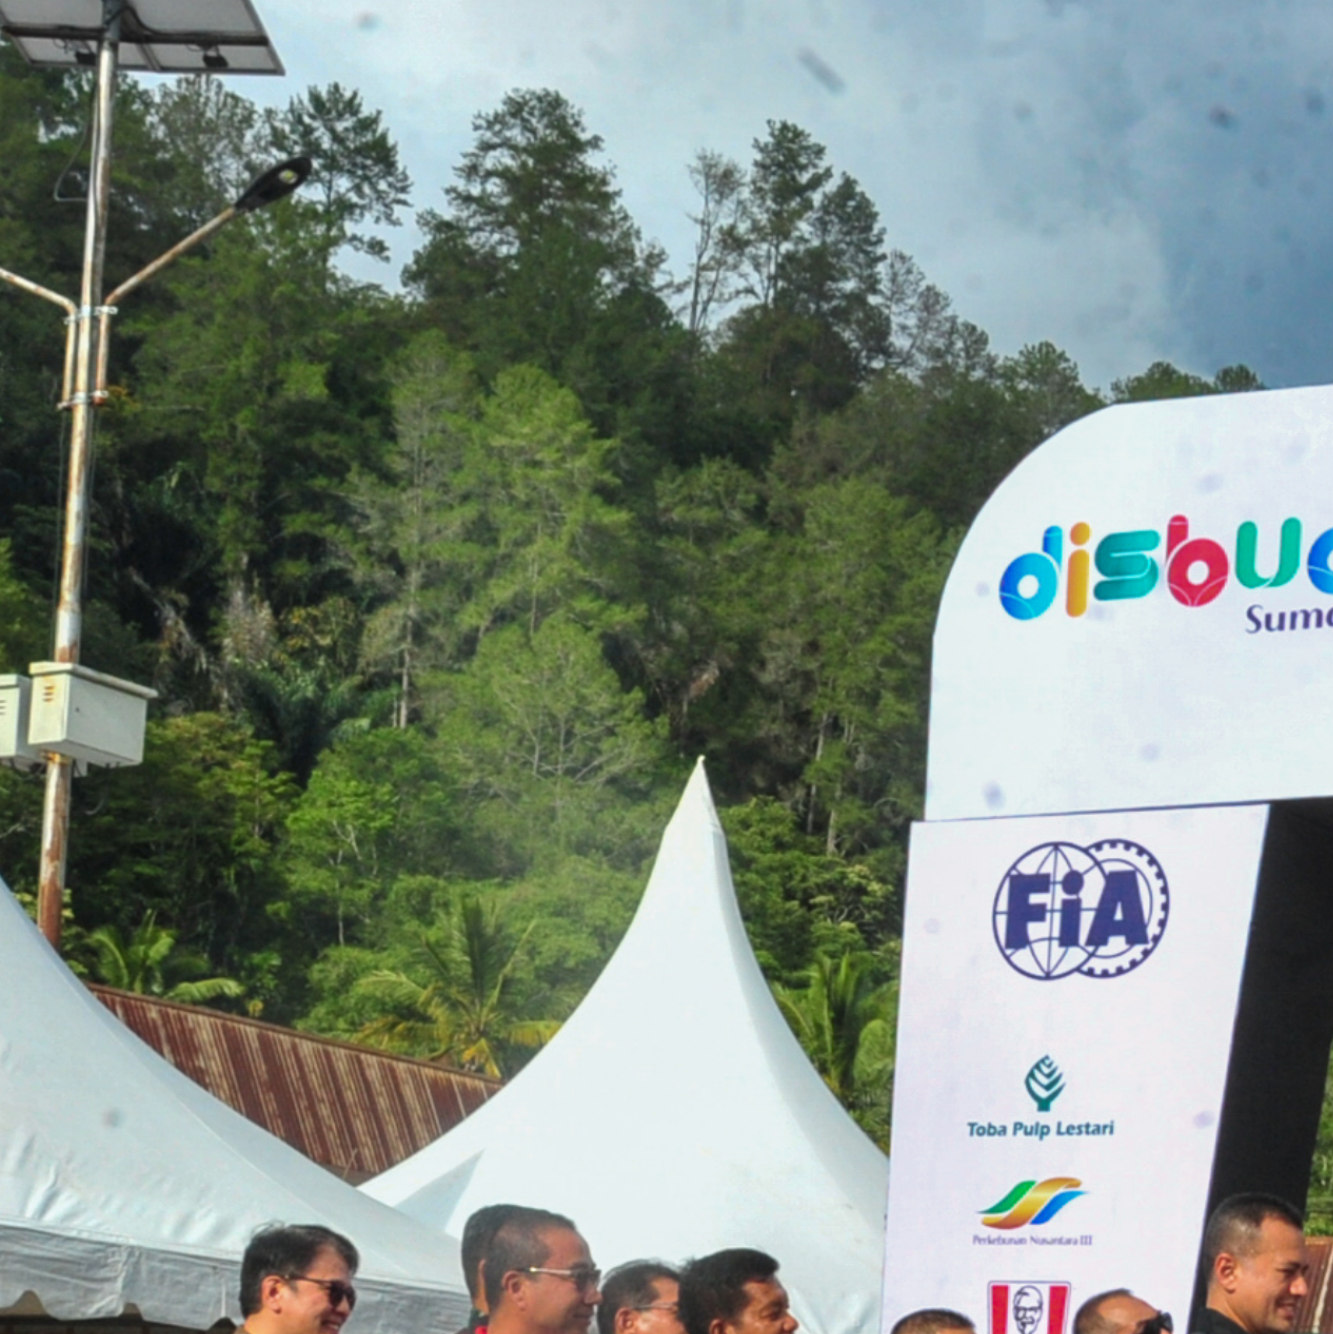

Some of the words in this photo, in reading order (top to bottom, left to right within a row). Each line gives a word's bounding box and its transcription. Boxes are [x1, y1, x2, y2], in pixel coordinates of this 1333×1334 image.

[966, 1121, 1008, 1137] Toba
[1012, 1121, 1051, 1141] Pulp
[1056, 1120, 1115, 1137] Lestari
